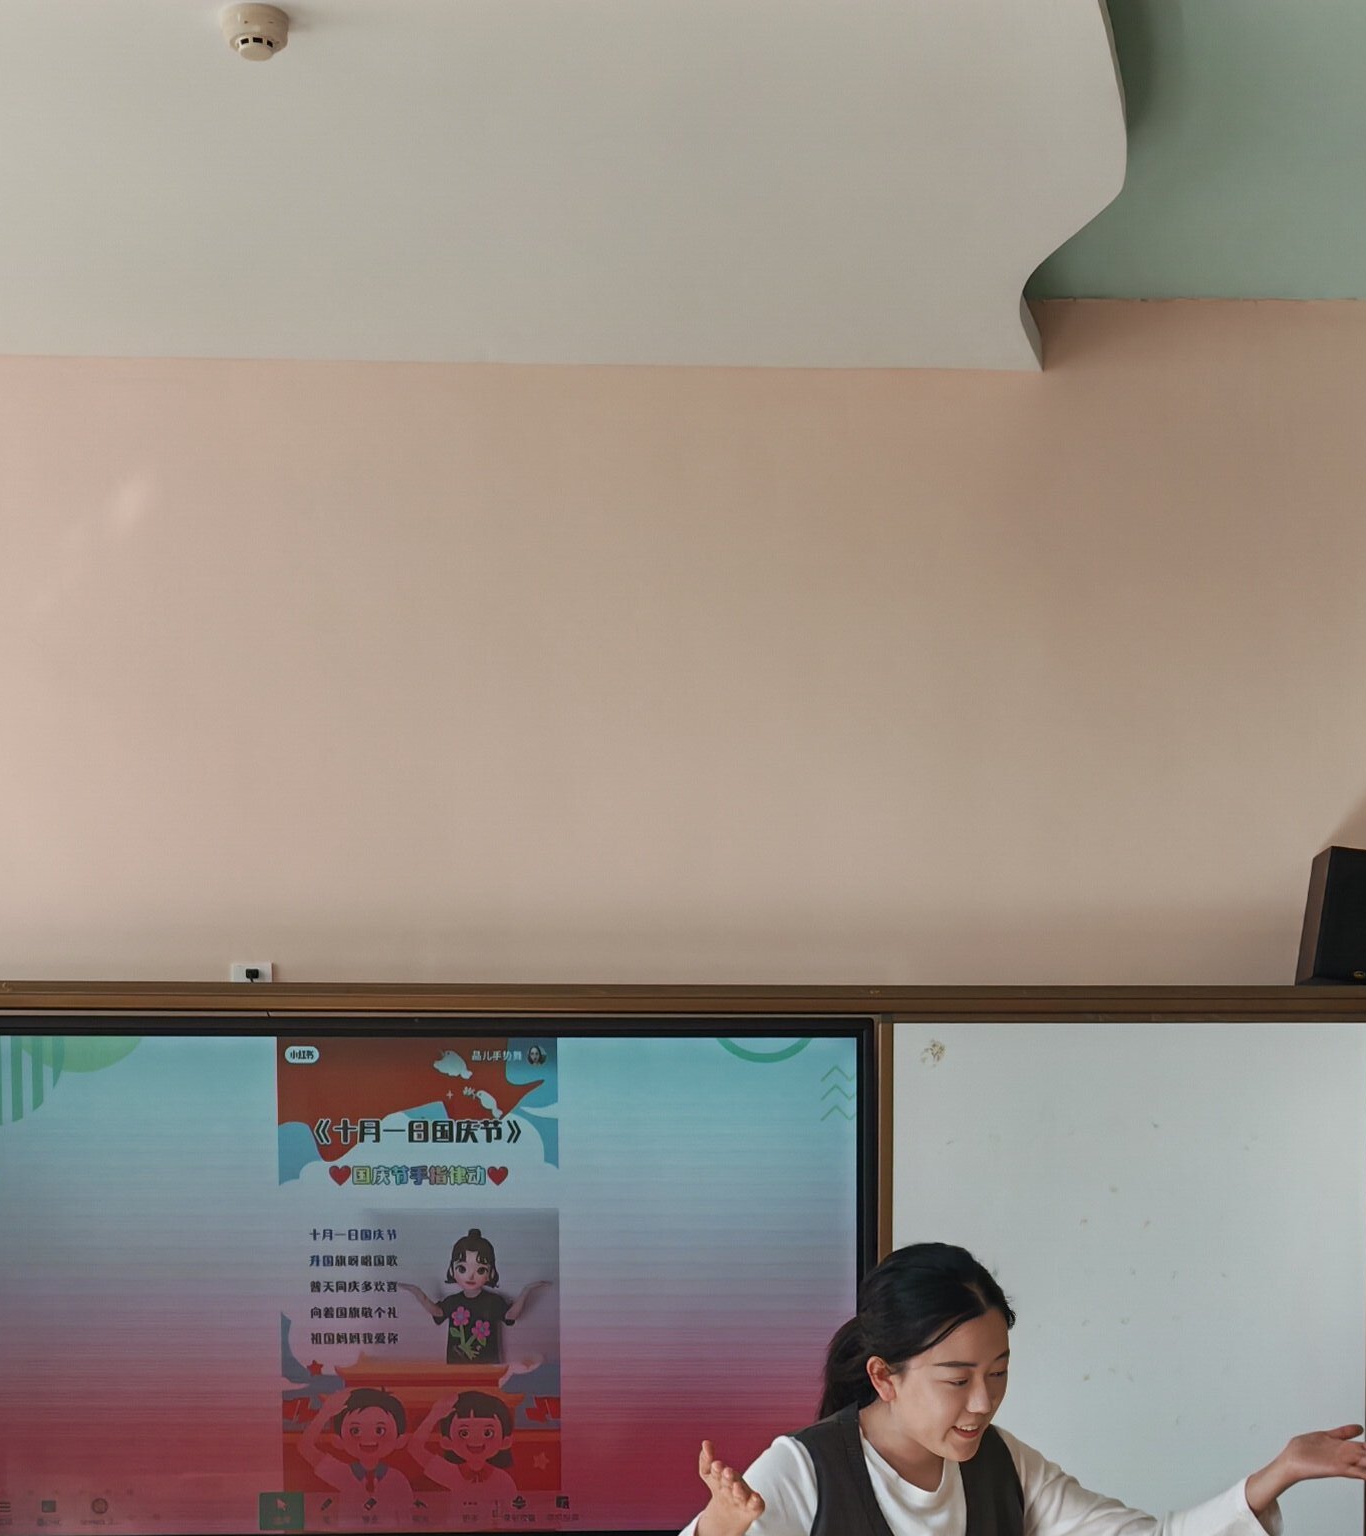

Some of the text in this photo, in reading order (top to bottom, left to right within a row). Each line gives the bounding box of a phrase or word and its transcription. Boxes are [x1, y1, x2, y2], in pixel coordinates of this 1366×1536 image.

[290, 1050, 314, 1060] 小红书
[313, 1118, 523, 1144] 《十月一日国庆节》
[352, 1164, 487, 1186] 国庆节手指律动
[309, 1228, 397, 1241] 十月一日国庆节
[309, 1254, 399, 1267] 升国旗呀唱国歌
[310, 1281, 398, 1293] 普天同庆多欢喜
[310, 1306, 399, 1319] 向着国旗敬个礼
[311, 1332, 399, 1345] 祖国妈妈我爱你
